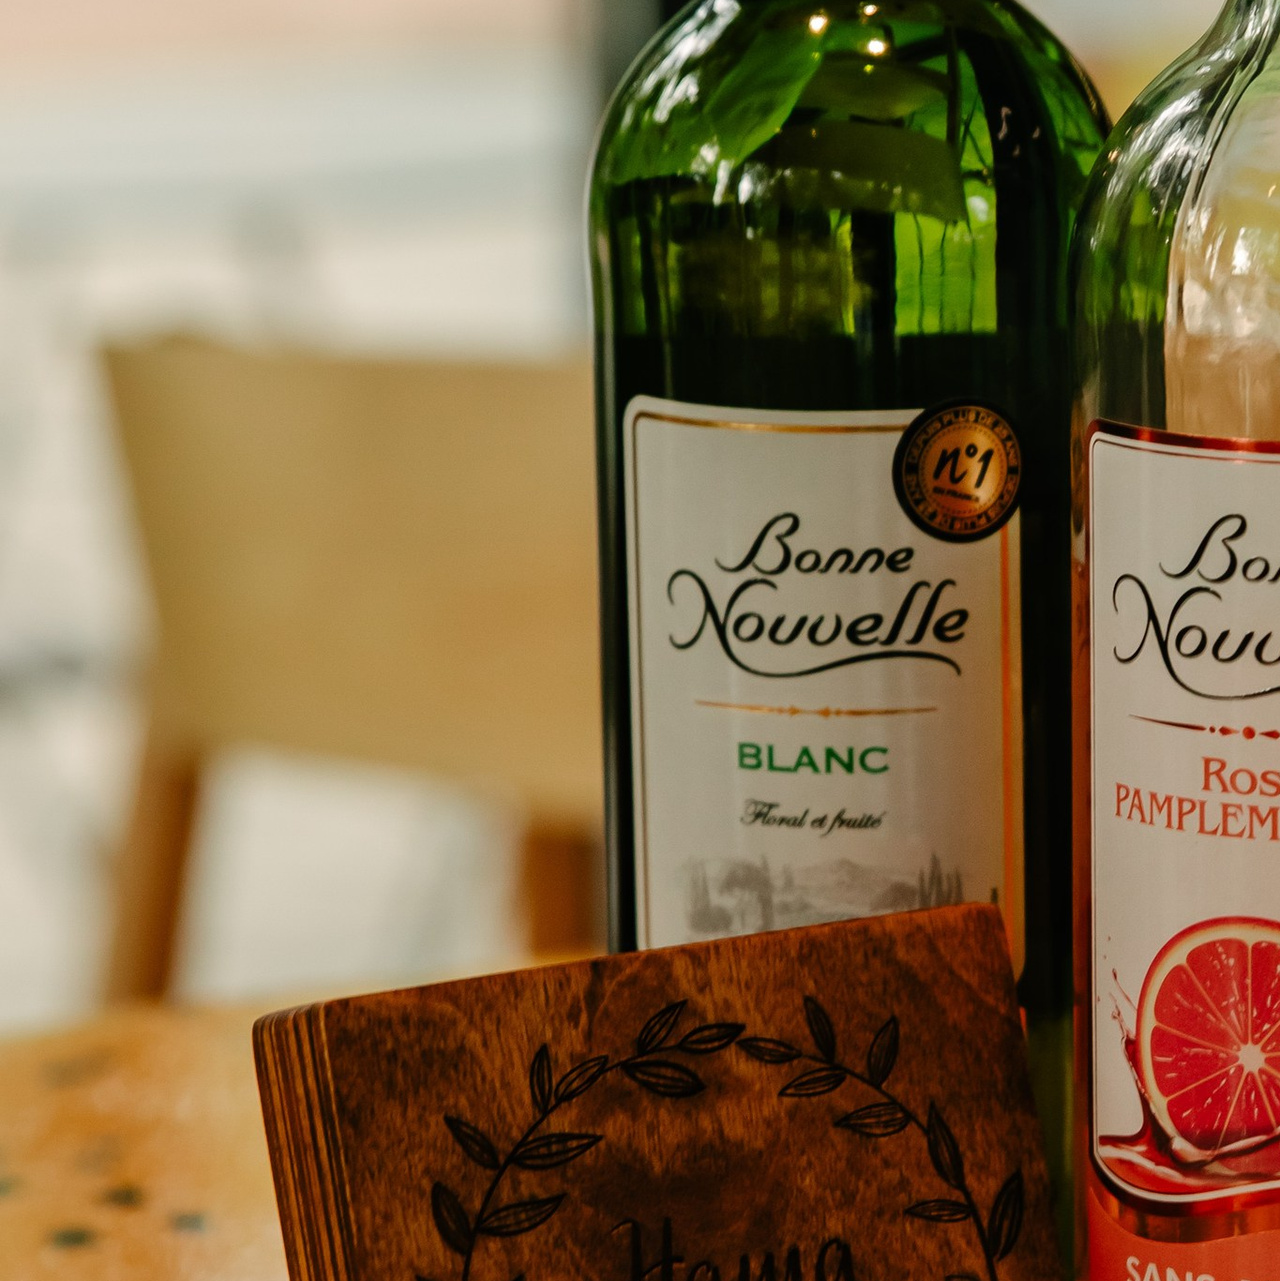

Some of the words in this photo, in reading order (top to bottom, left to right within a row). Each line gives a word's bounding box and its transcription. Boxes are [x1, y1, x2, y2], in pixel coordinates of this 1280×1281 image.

[714, 511, 914, 575] Bonne
[668, 569, 970, 679] Nouvelle
[737, 741, 890, 775] BLANC
[740, 798, 806, 830] Floral
[810, 813, 827, 830] et
[826, 808, 884, 839] fruité
